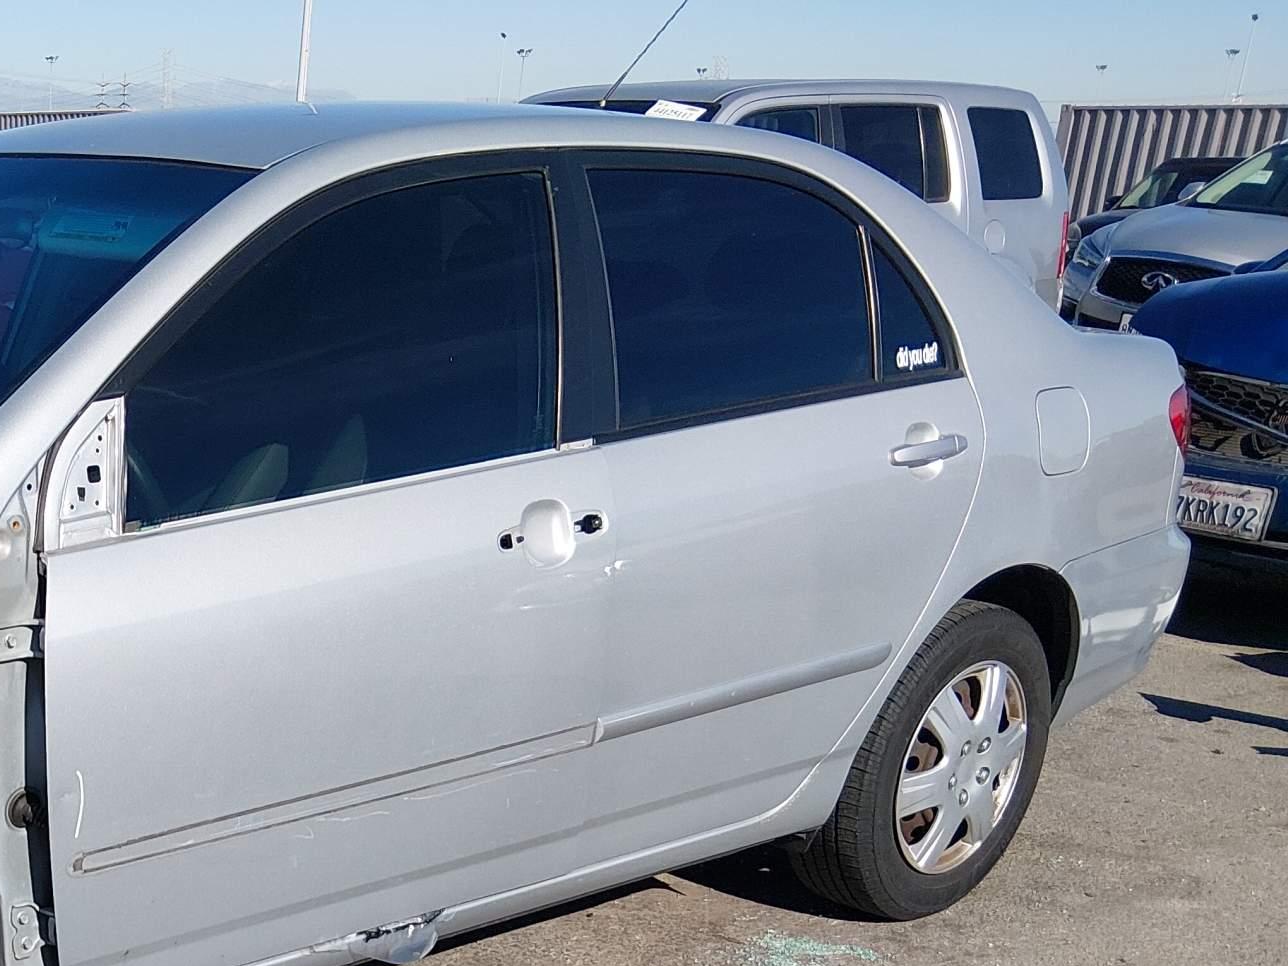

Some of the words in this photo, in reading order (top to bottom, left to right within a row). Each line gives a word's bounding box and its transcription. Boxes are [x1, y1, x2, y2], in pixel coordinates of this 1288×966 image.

[896, 346, 909, 368] did
[908, 348, 923, 371] you
[1190, 482, 1246, 500] California
